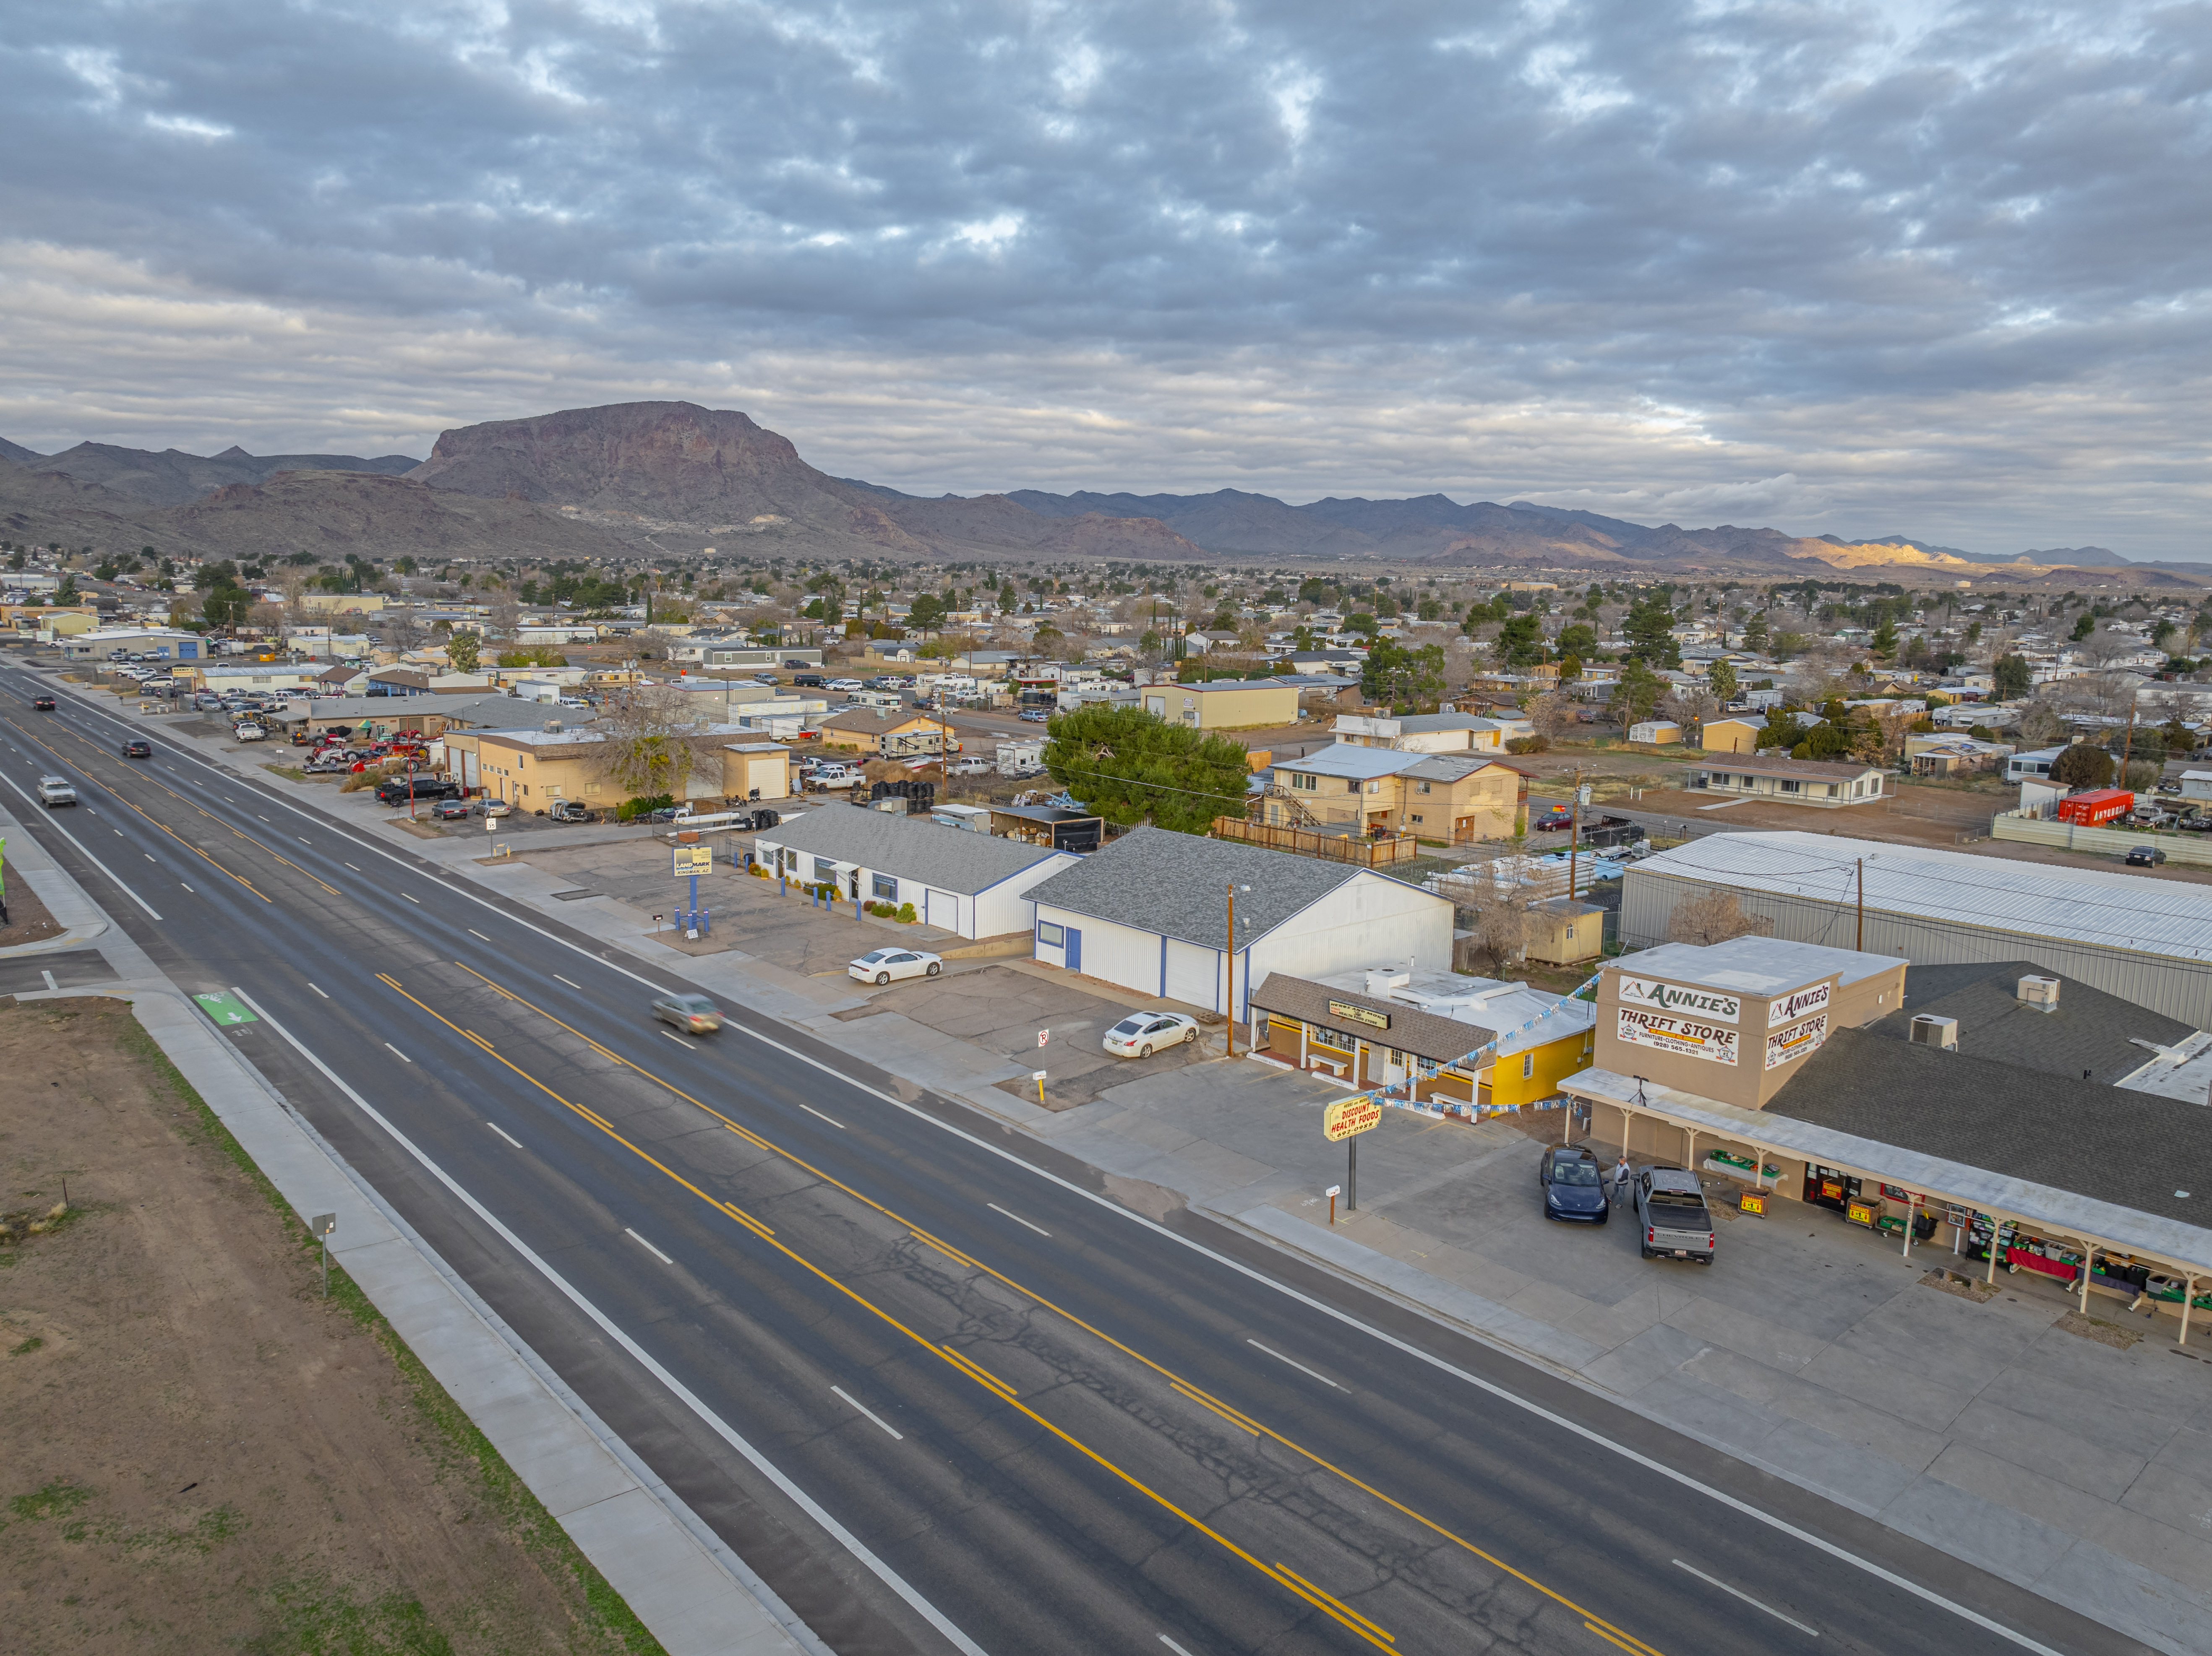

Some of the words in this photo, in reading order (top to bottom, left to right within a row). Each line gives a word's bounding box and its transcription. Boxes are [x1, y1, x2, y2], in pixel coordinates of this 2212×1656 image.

[2099, 805, 2125, 819] HYUNDAI
[1647, 984, 1738, 1015] ANNIE'S
[1784, 985, 1829, 1018] ANNIE'S
[1367, 1012, 1385, 1021] MORE
[1620, 1010, 1677, 1031] THRIFT
[1680, 1023, 1737, 1046] STORE
[1768, 1026, 1798, 1049] THRIFT
[1800, 1015, 1826, 1036] STORE
[1639, 1032, 1663, 1042] FURNITURE
[1665, 1038, 1688, 1047] CLOTHING
[1691, 1043, 1714, 1053] ANTIQUES
[1671, 1045, 1698, 1055] 565-1321
[1342, 1103, 1370, 1120] DISCOUNT
[1331, 1117, 1356, 1133] HEALTH
[1359, 1109, 1379, 1124] FOODS
[1337, 1122, 1373, 1137] 692-0988
[1742, 1196, 1761, 1204] CLEARANCE
[1851, 1205, 1869, 1214] CLEARANCE
